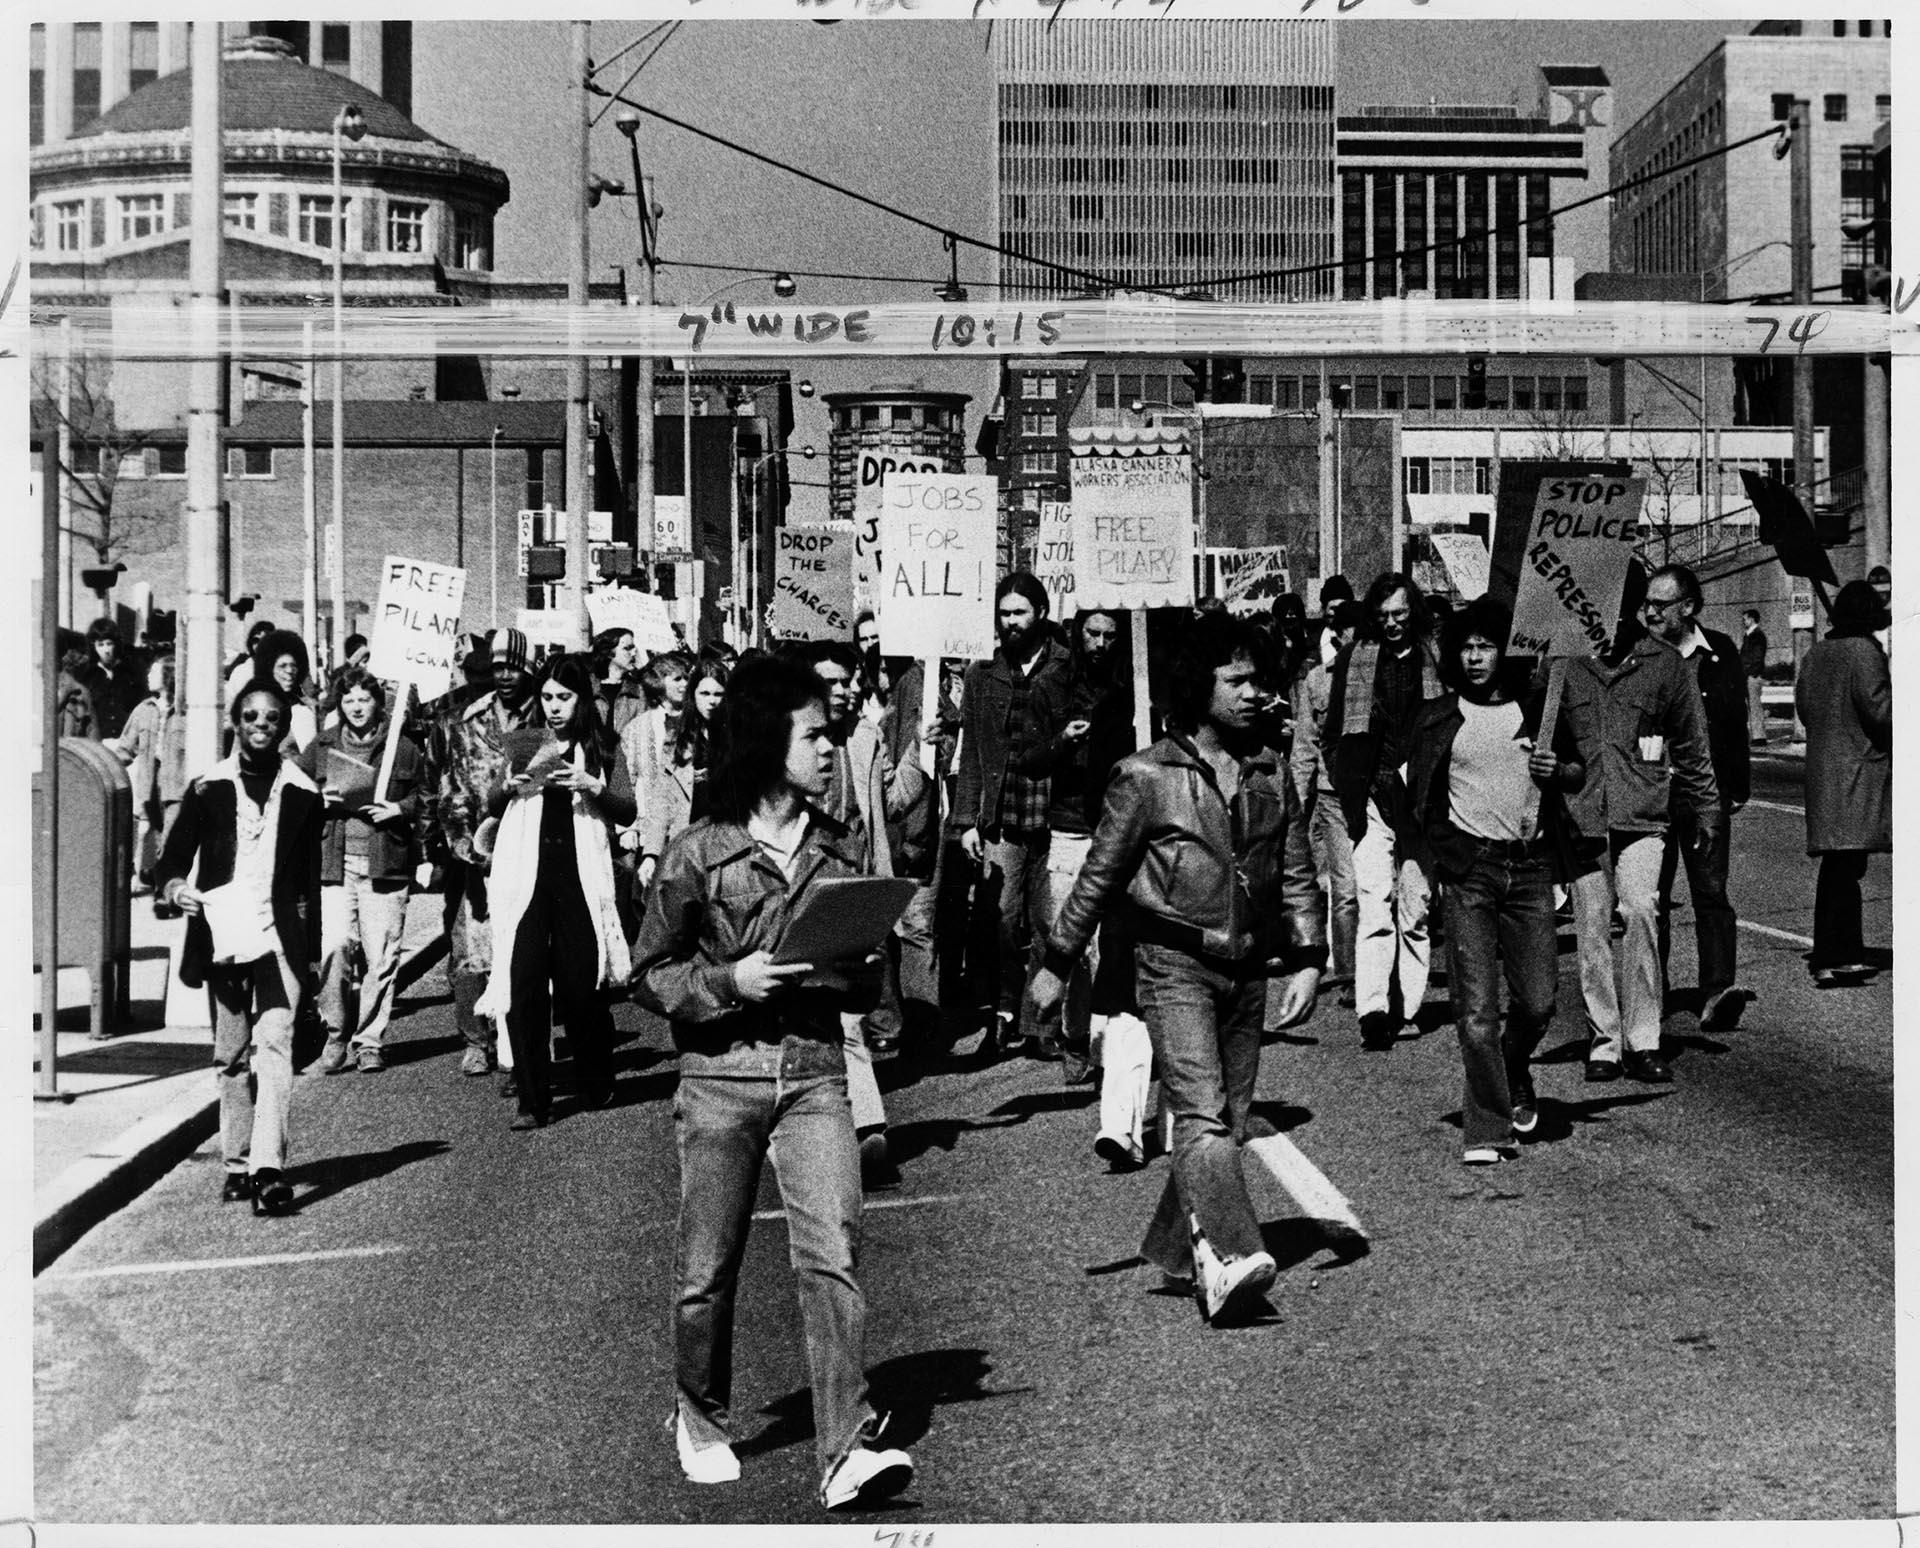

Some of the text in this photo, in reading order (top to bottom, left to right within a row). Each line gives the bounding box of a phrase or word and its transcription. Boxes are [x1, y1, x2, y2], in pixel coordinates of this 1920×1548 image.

[746, 310, 870, 344] WIDE
[932, 311, 1066, 351] 10:15
[1073, 456, 1182, 473] ALASKA CANNERY
[1123, 470, 1191, 488] ASSOCIATION
[894, 484, 983, 511] JOBS
[1549, 481, 1626, 505] STOP
[908, 523, 964, 551] FOR
[1094, 516, 1156, 542] FREE
[1537, 509, 1639, 541] POLICE
[780, 532, 834, 552] DROP
[789, 556, 827, 572] THE
[390, 564, 458, 598] FREE
[776, 576, 849, 630] CHARGES
[1528, 541, 1614, 654] REPRESSION
[1793, 604, 1811, 613] STOP
[1794, 595, 1810, 604] BUS
[780, 629, 809, 640] UCWA
